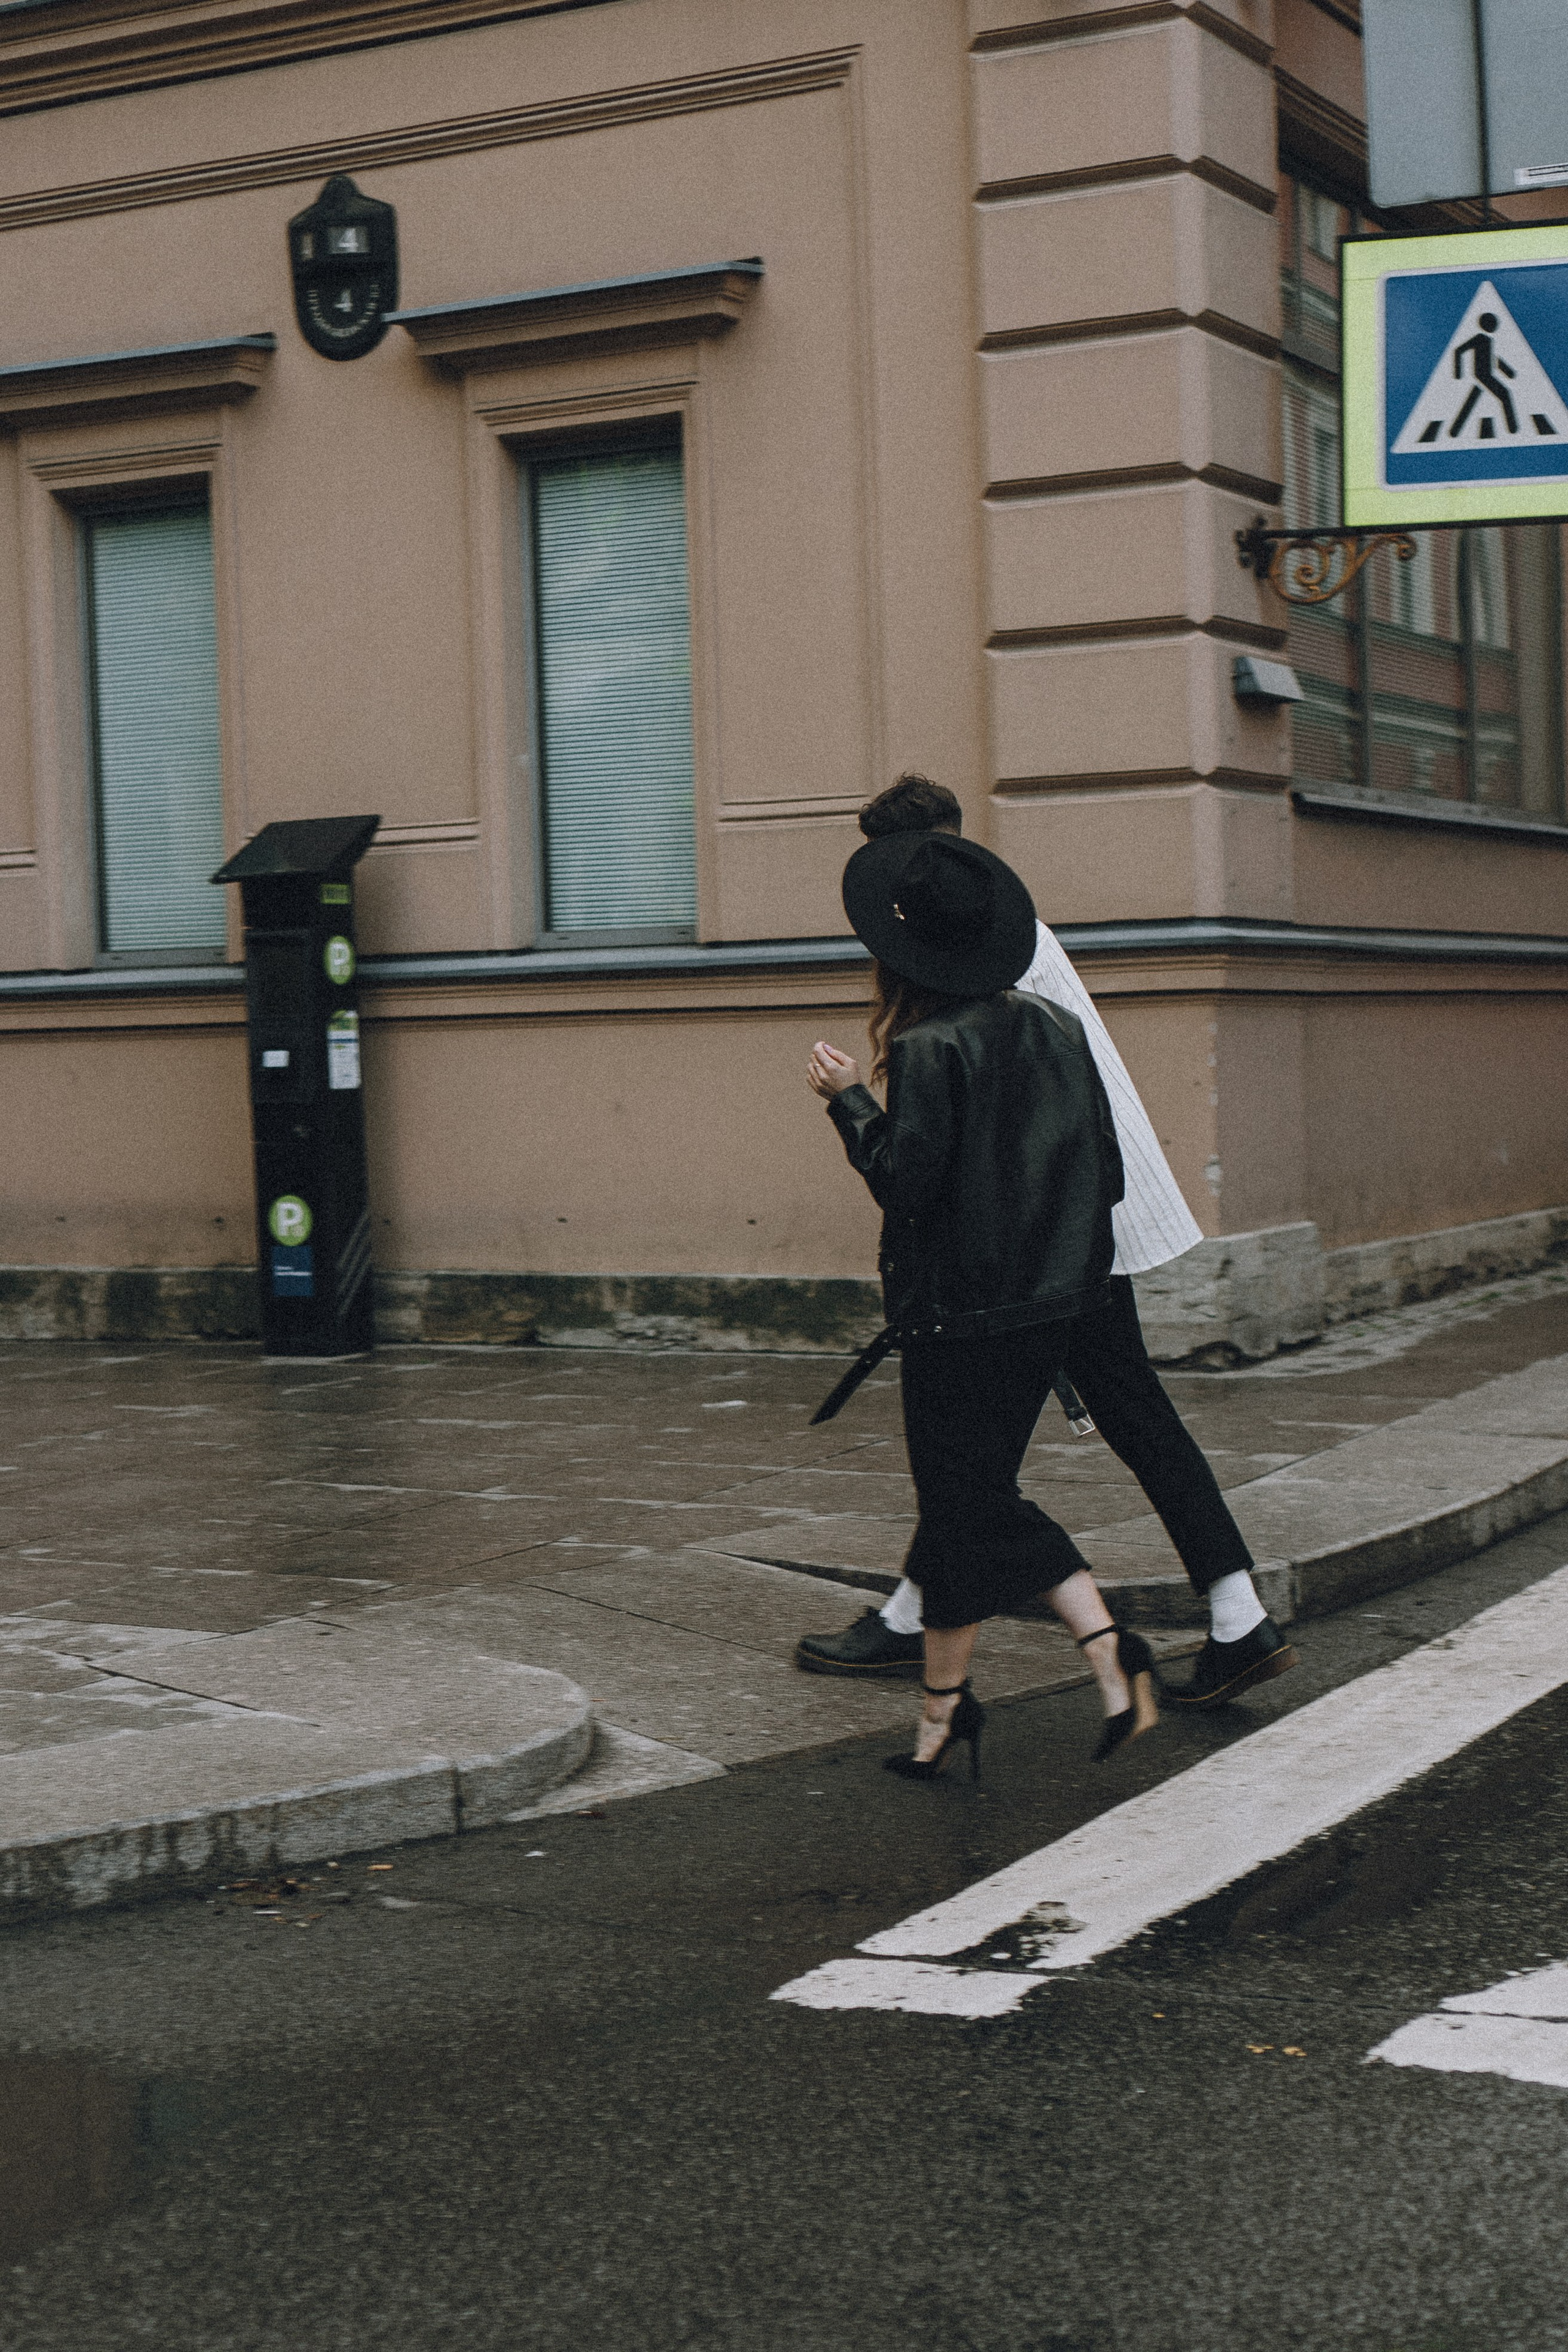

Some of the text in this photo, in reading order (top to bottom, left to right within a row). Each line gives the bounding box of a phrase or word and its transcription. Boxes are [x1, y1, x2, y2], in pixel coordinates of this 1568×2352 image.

[337, 228, 358, 252] 4
[330, 943, 350, 976] P
[277, 1203, 304, 1236] P
